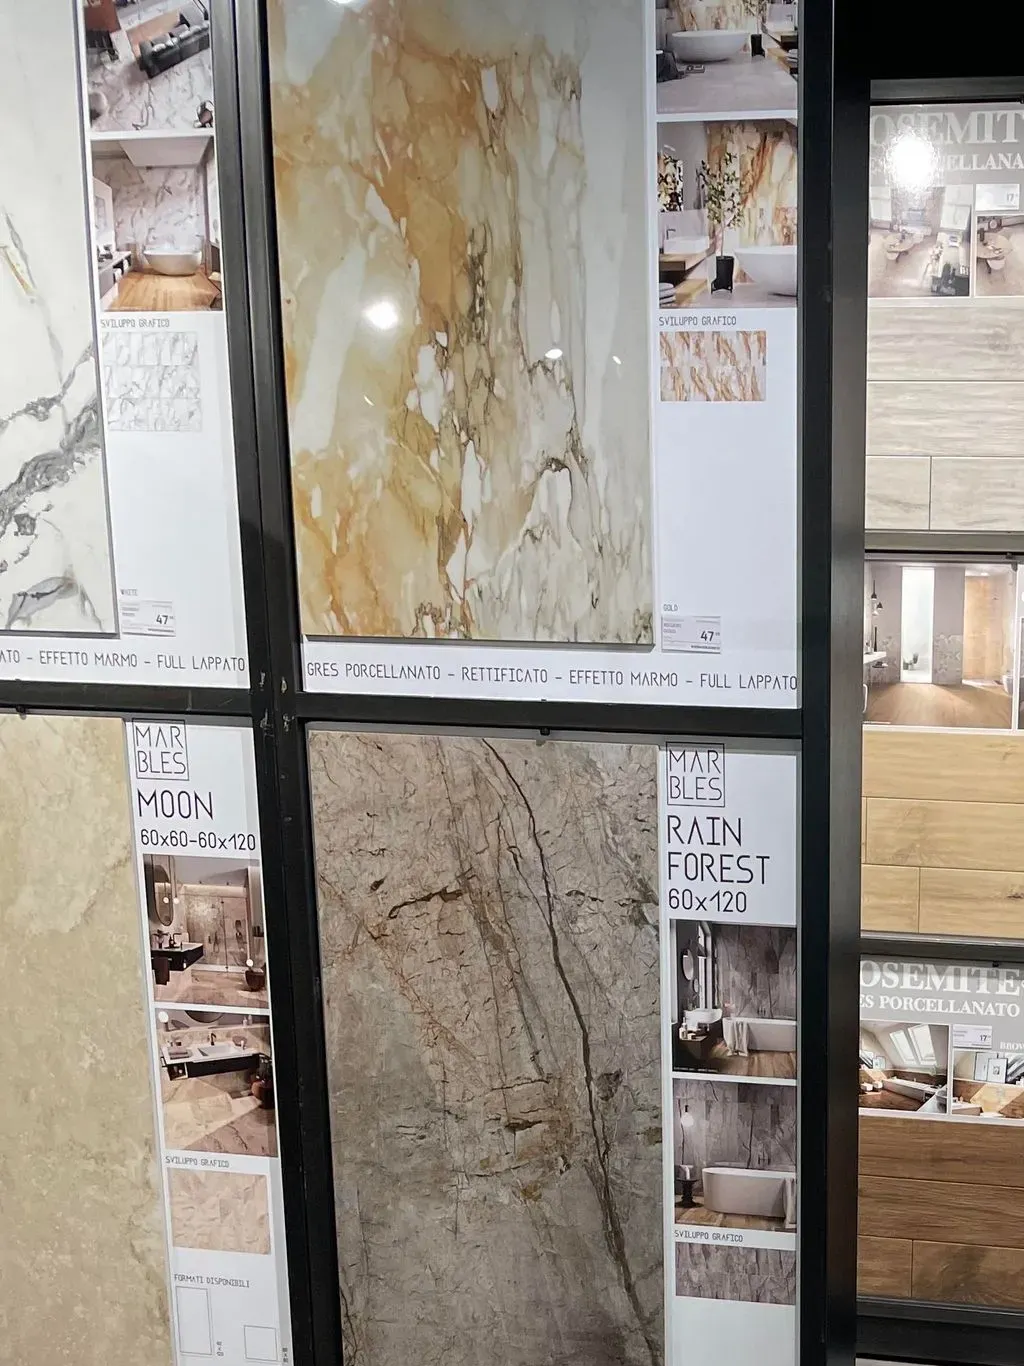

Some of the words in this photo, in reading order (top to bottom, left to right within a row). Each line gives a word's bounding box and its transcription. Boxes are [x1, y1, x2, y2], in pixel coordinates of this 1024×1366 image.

[100, 319, 136, 328] SVILUPPO
[139, 318, 170, 328] GRAFICO
[658, 316, 698, 327] SVILUPPO
[701, 316, 737, 326] GRAFICO
[39, 650, 89, 666] EFFETTO
[94, 652, 138, 668] MARMO
[157, 654, 187, 670] FULL
[192, 655, 245, 672] LAPPATO
[307, 662, 339, 677] GRES
[345, 663, 441, 680] PORCELLANATO
[461, 666, 548, 683] RETTIFICATO
[569, 669, 623, 685] EFFETTO
[630, 672, 678, 687] MARMO
[700, 673, 732, 689] FULL
[739, 674, 797, 691] LAPPATO
[134, 725, 184, 749] MAR
[137, 750, 187, 775] BLES
[669, 749, 722, 774] MAR
[669, 775, 723, 801] BLES
[137, 788, 214, 820] MOON
[140, 828, 257, 851] 60x60-60x120
[667, 814, 742, 847] RAIN
[667, 851, 771, 885] FOREST
[668, 887, 748, 913] 60x120
[860, 960, 1021, 997] OSEMITE
[879, 995, 1021, 1018] PORCELLANATO
[165, 1155, 198, 1166] SVILUPPO
[200, 1158, 230, 1168] GRAFICO
[674, 1229, 709, 1240] SVILUPPO
[711, 1232, 744, 1243] GRAFICO
[174, 1273, 204, 1284] FORMATI
[206, 1276, 250, 1288] DISPONIBILI
